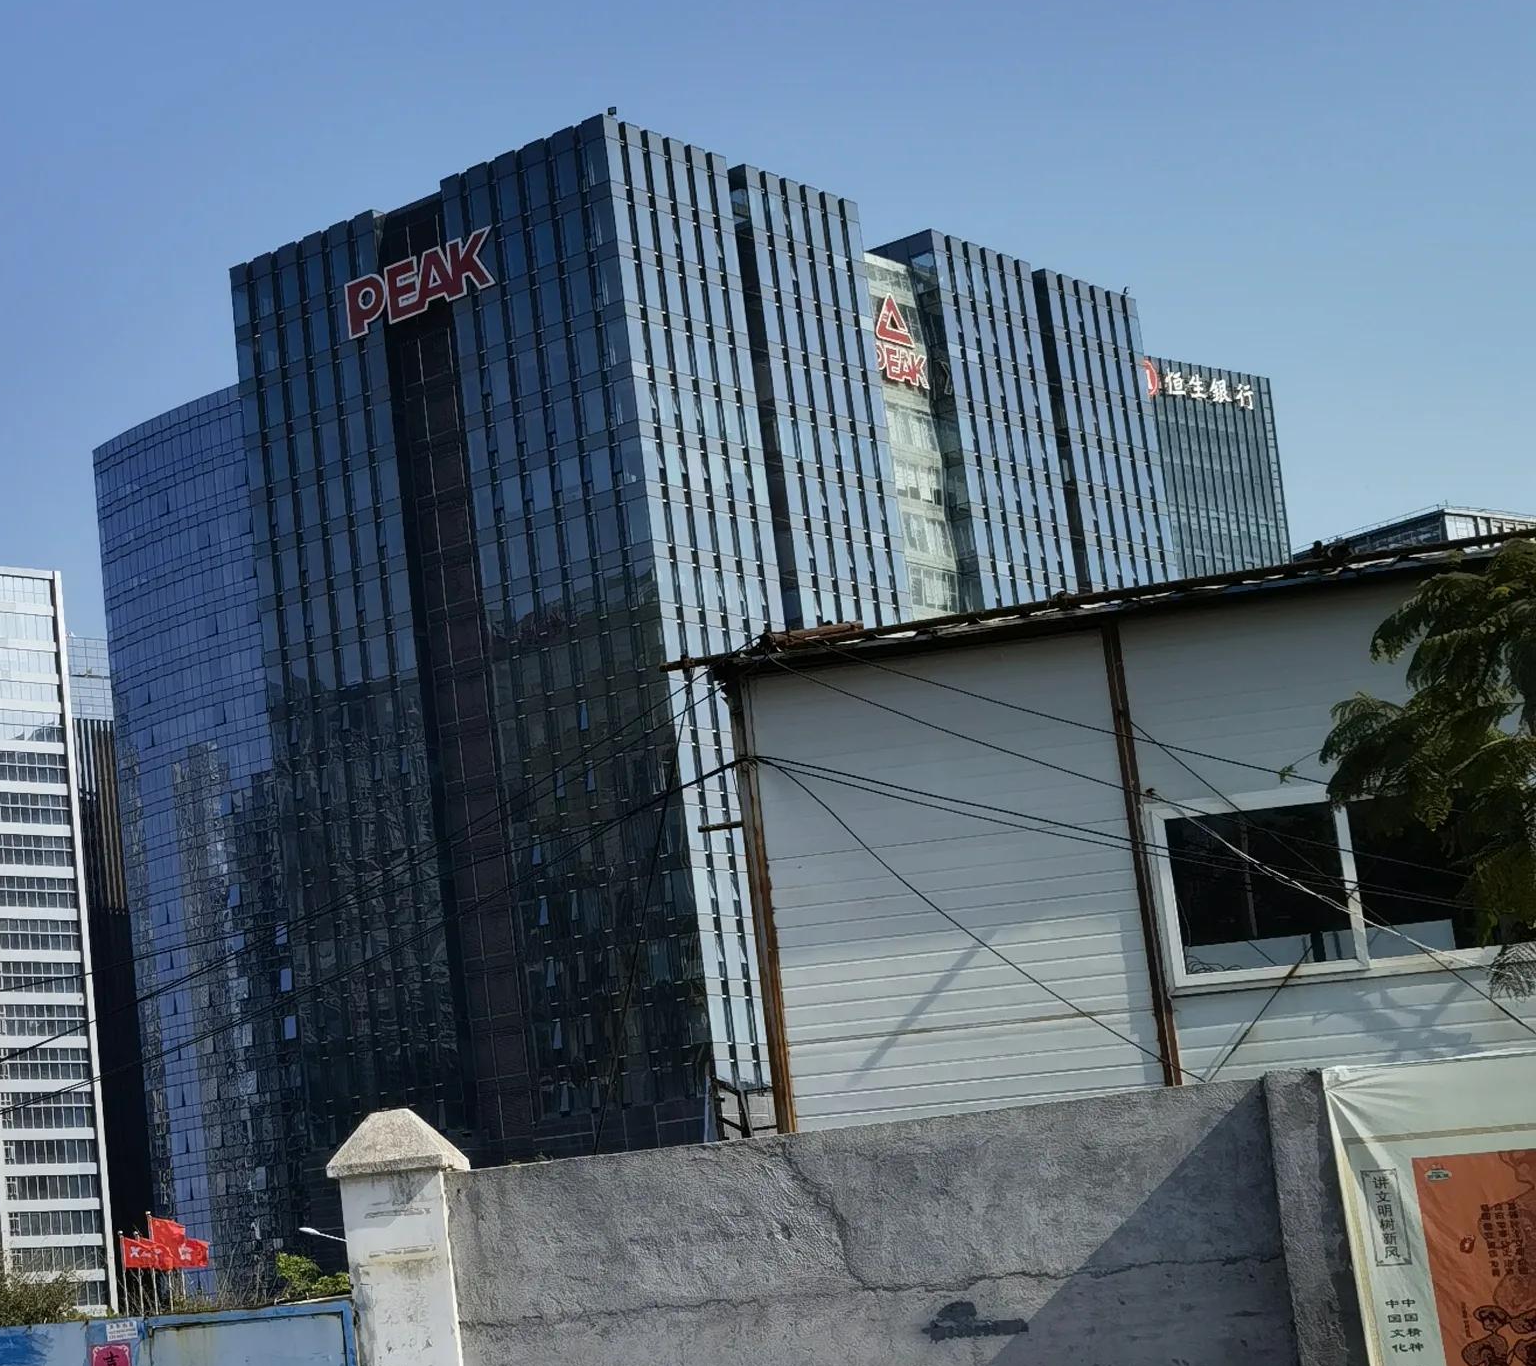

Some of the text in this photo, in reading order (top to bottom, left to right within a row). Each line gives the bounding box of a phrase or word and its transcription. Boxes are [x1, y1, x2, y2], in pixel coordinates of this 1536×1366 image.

[344, 224, 496, 340] PEAK
[1369, 1176, 1401, 1259] 讲文明树新风
[1385, 1299, 1409, 1353] 中国文化
[1401, 1298, 1424, 1352] 中国精神
